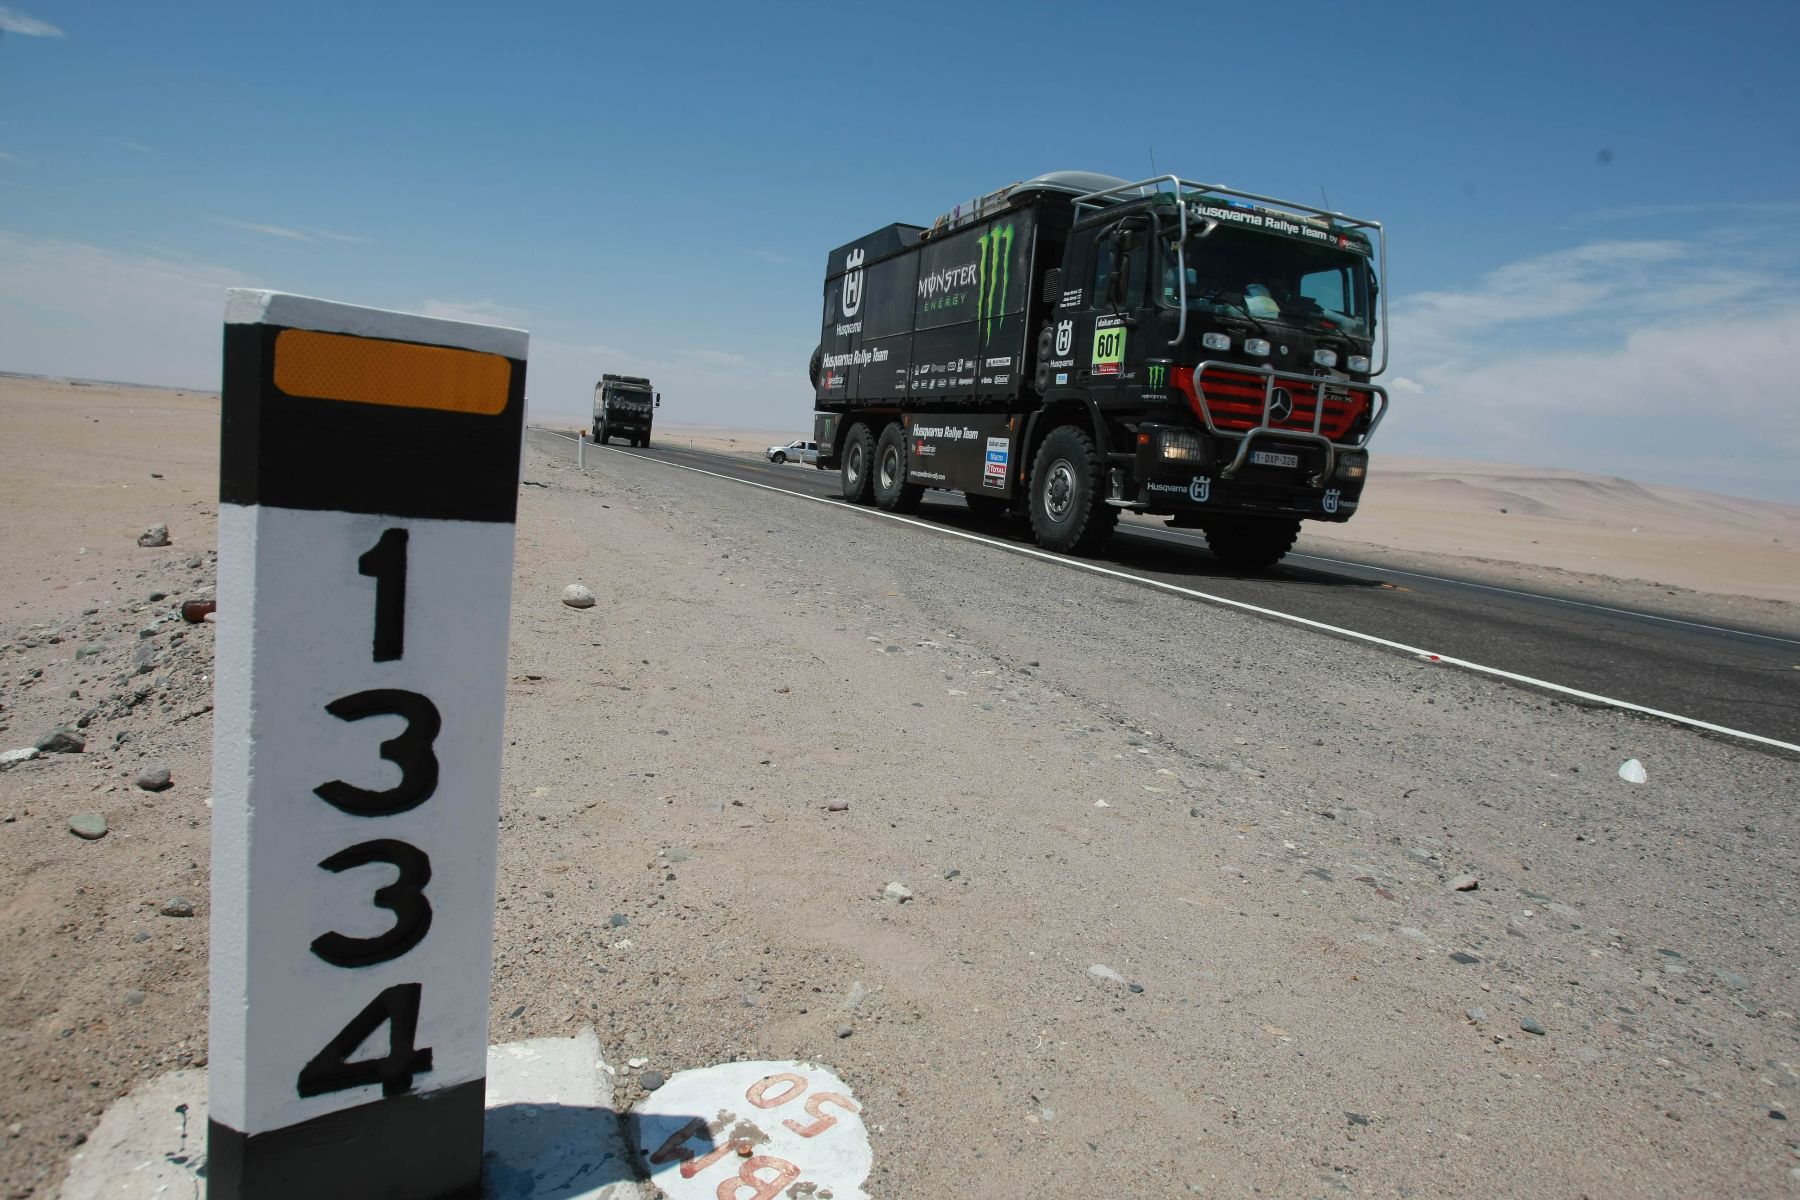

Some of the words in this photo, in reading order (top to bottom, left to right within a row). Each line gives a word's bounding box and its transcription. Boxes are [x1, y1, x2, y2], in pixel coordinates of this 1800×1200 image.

[1191, 203, 1262, 225] Husqvarna
[1265, 217, 1299, 234] Rallye
[1301, 225, 1327, 240] Team
[1329, 235, 1338, 244] by
[918, 264, 977, 299] MONSTER
[924, 295, 966, 312] ENERGY
[836, 320, 862, 336] Husqvarna
[1097, 332, 1120, 358] 601
[822, 353, 853, 371] Husqvarna
[853, 349, 871, 367] Rallye
[872, 347, 889, 362] Team
[1050, 358, 1074, 368] Husqvarna
[912, 423, 944, 440] Husqvarna
[944, 426, 963, 442] Rallye
[962, 427, 979, 440] Team
[990, 465, 1005, 474] TOTAL
[1147, 482, 1187, 493] Husqvarna
[298, 528, 442, 1098] 1334
